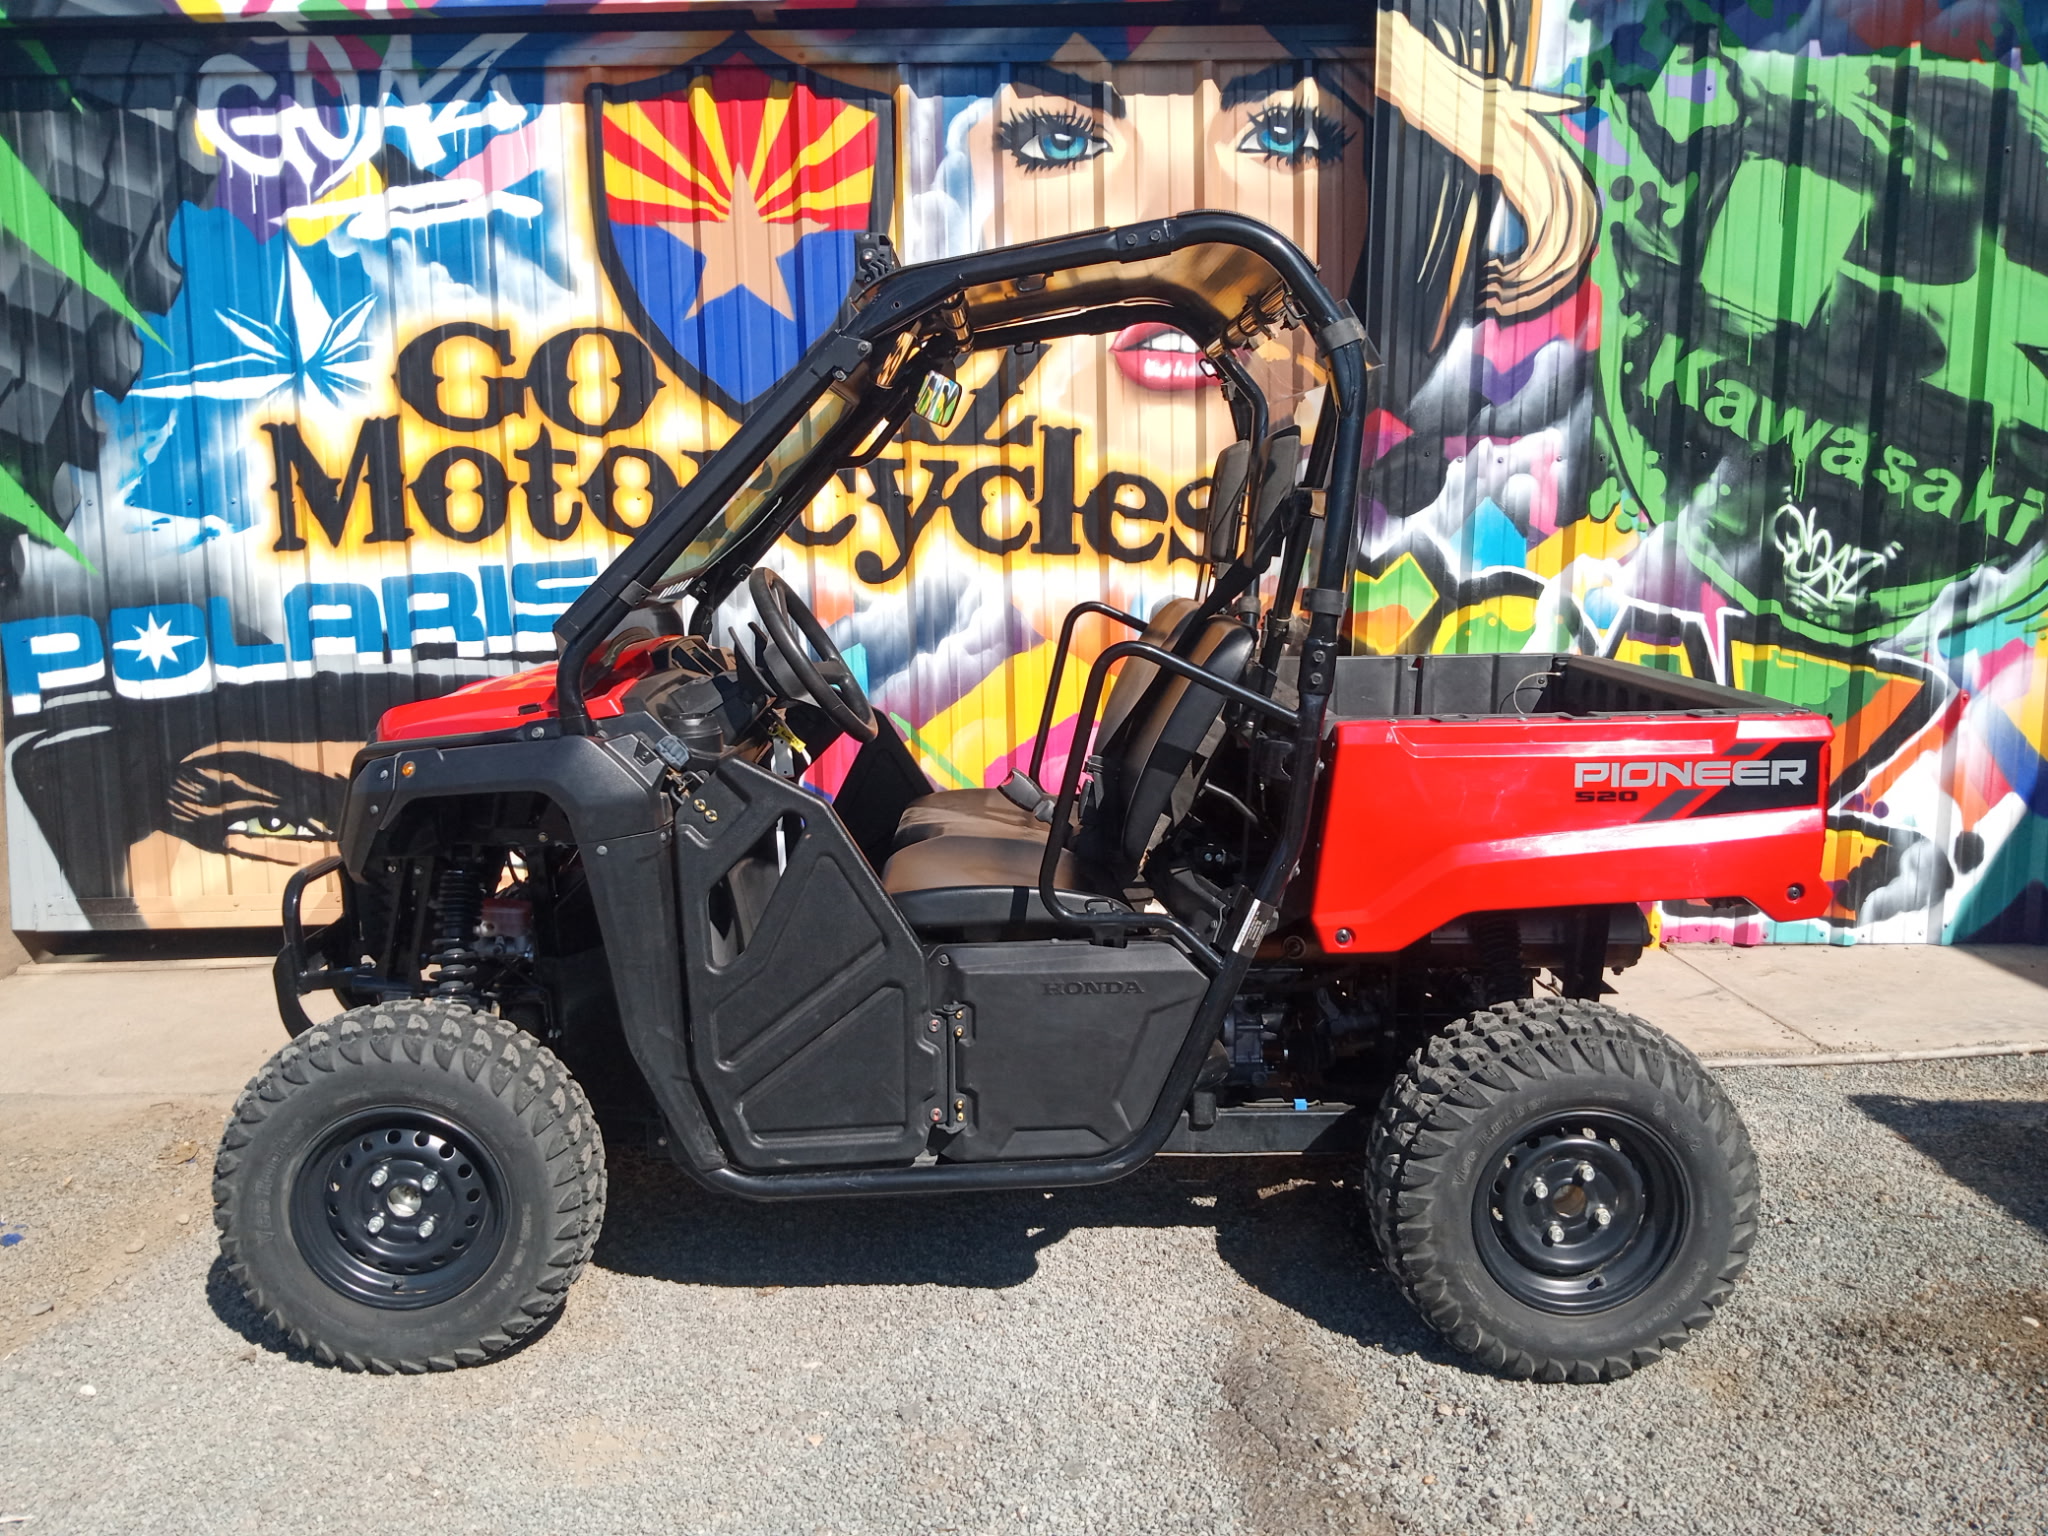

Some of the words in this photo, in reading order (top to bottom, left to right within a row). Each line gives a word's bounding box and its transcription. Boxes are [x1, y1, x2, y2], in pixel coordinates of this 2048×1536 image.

[392, 322, 667, 438] GO
[1640, 333, 2047, 547] Kawasaki
[0, 556, 599, 702] POLARIS
[1574, 759, 1807, 788] PIONEER
[1575, 790, 1638, 803] 520
[1042, 980, 1145, 996] HONDA
